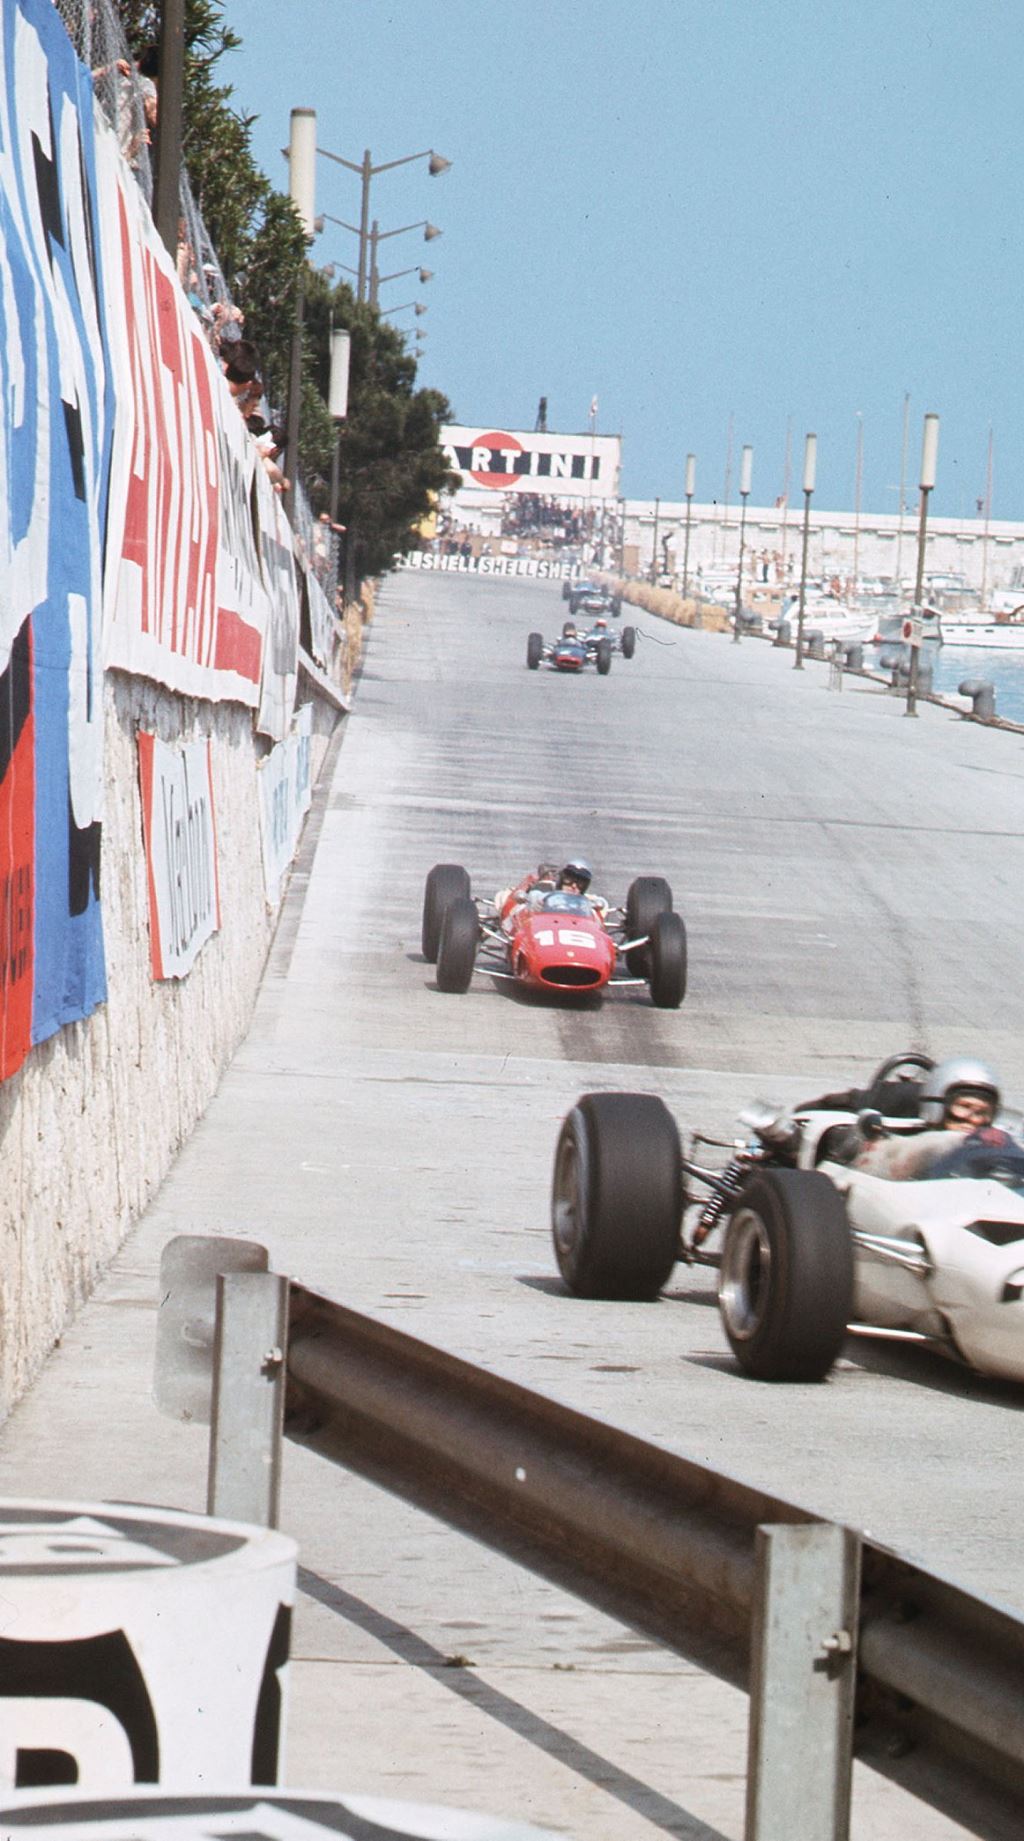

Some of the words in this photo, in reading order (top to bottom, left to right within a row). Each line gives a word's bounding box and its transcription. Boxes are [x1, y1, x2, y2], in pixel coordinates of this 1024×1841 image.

[441, 445, 593, 479] ARTINI
[422, 552, 478, 574] SHELL
[481, 557, 534, 577] SHELL
